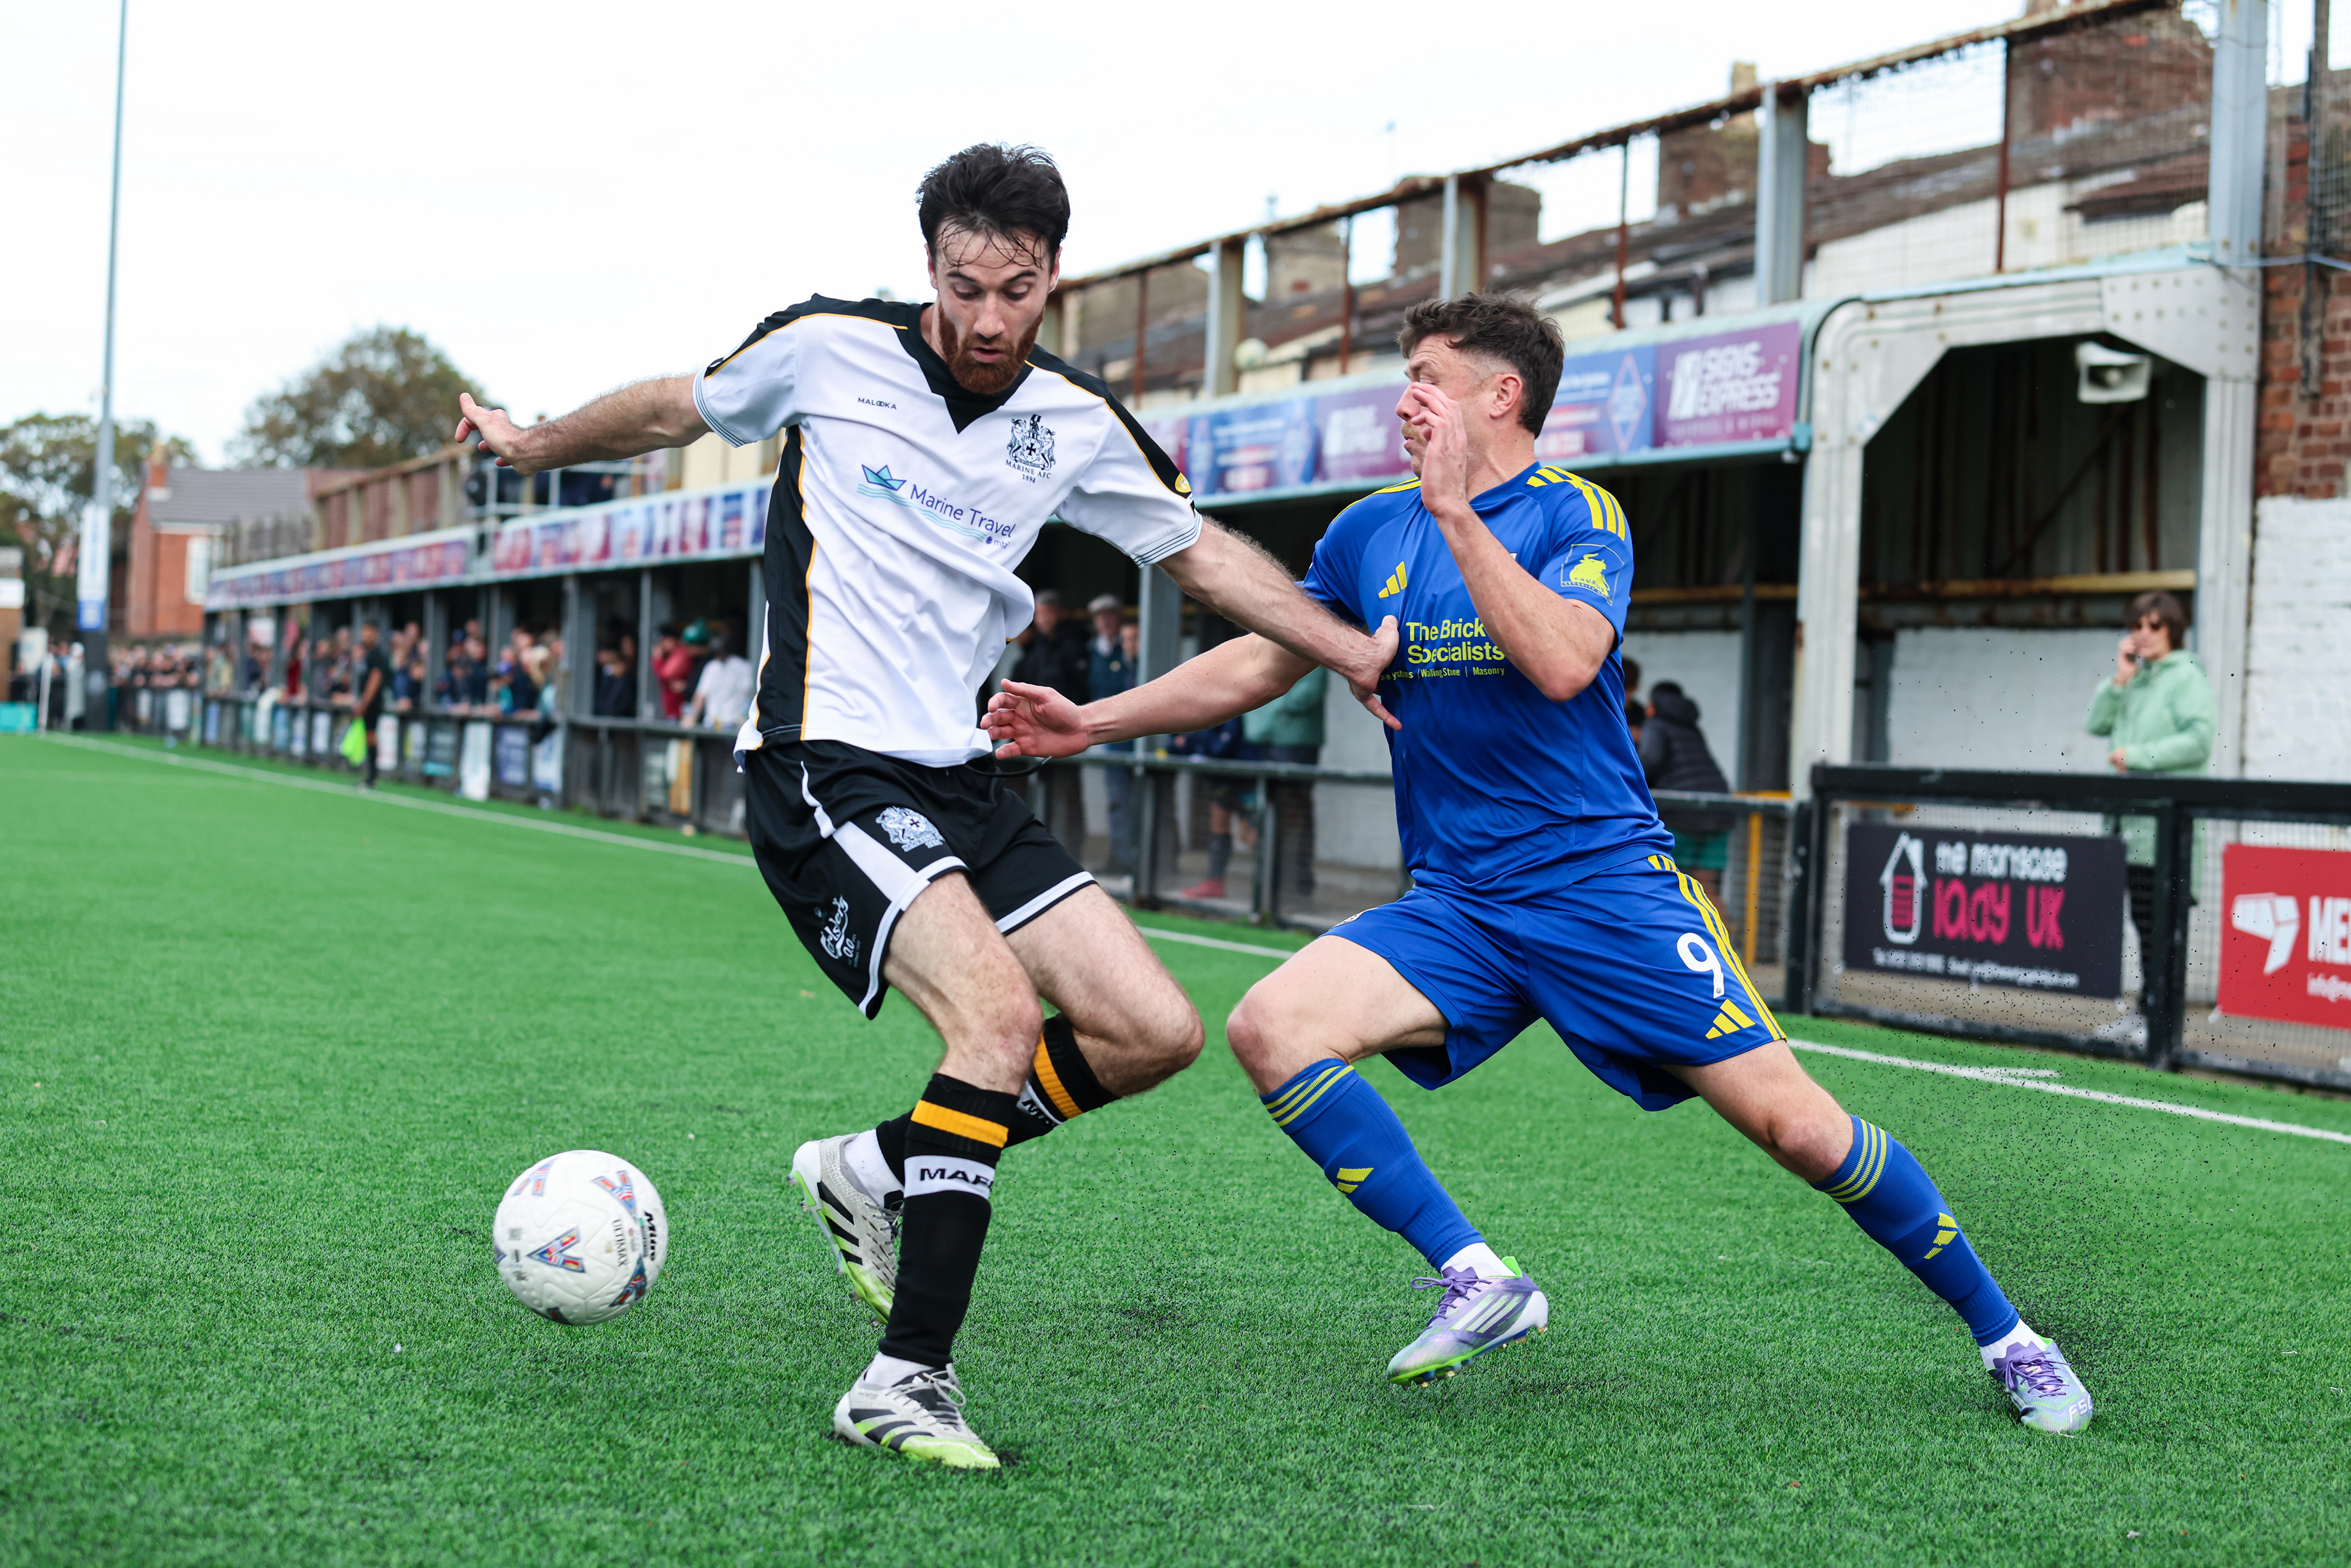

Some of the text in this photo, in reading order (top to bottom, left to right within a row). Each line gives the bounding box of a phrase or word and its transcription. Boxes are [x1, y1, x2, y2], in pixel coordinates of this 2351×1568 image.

[858, 397, 896, 410] MALOOKA
[1006, 459, 1035, 475] MARINE
[1022, 474, 1035, 483] 1894
[910, 484, 1016, 538] Marine Travel
[1406, 617, 1487, 642] The Brick
[1408, 641, 1505, 664] Specialists
[1472, 666, 1505, 676] Masonry
[1933, 877, 2066, 950] lady UK
[2307, 895, 2351, 966] ME
[1677, 932, 1725, 999] 9
[612, 1218, 628, 1267] ULTIMAX
